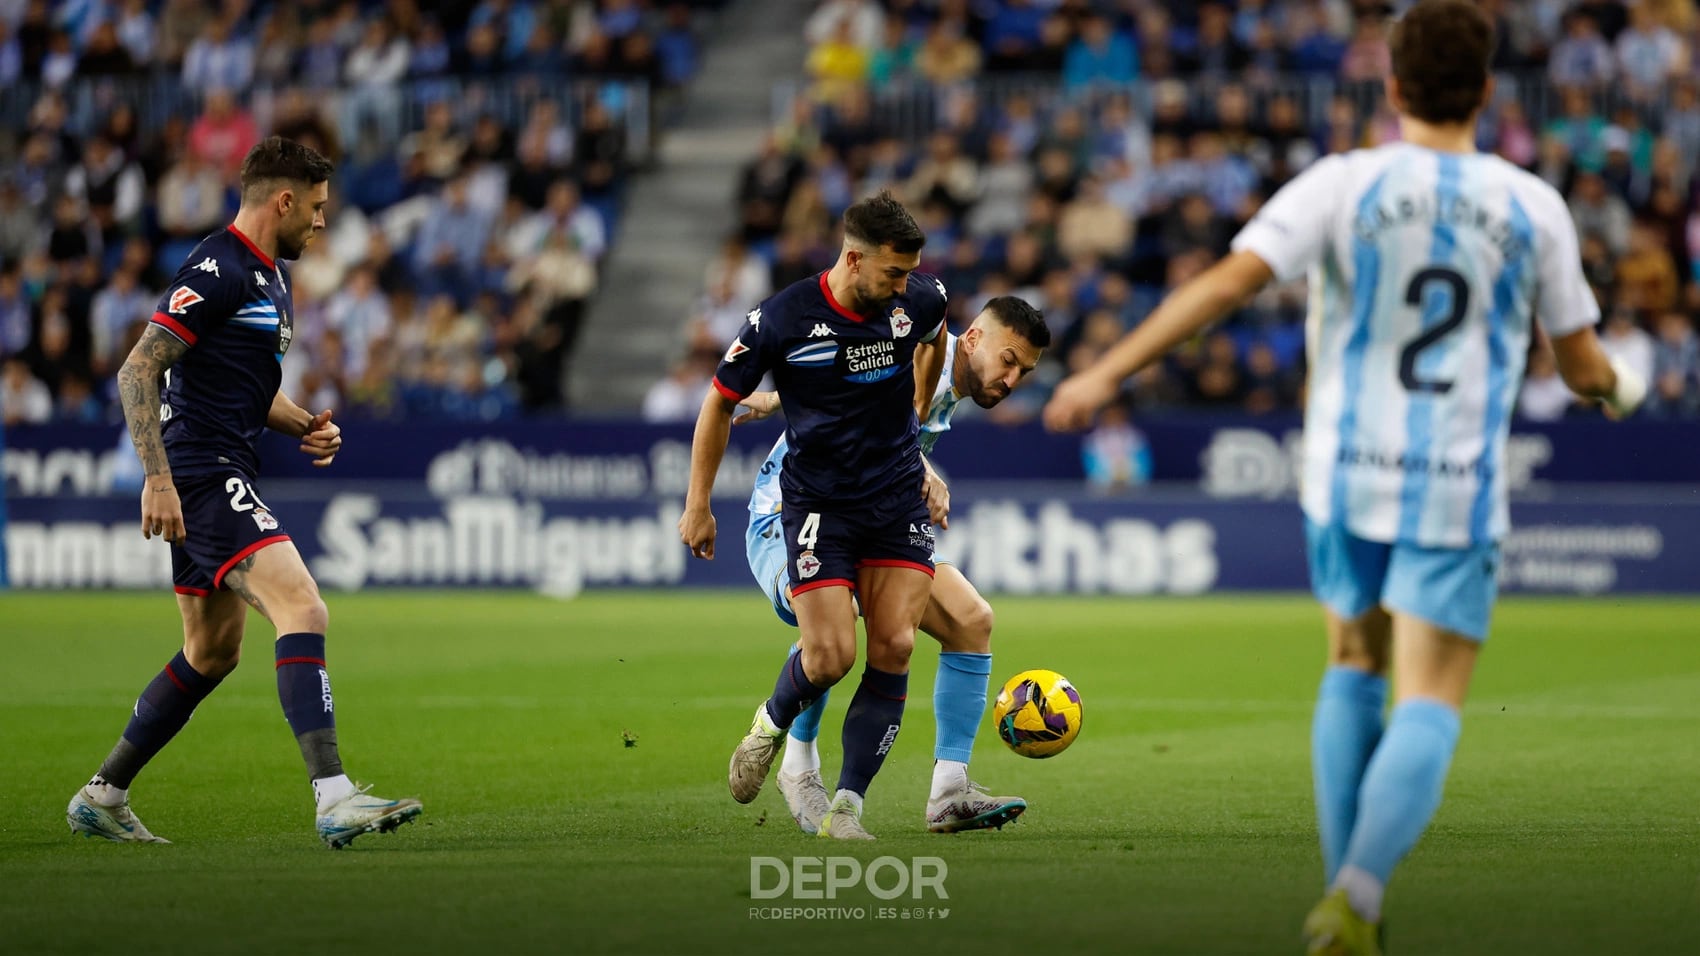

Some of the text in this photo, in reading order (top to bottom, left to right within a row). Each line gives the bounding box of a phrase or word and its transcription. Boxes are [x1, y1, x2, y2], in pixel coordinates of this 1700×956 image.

[1397, 267, 1471, 395] 2
[846, 341, 894, 360] Estrella
[848, 354, 894, 373] Galicia
[797, 512, 822, 550] 4
[318, 668, 333, 713] DEPOR
